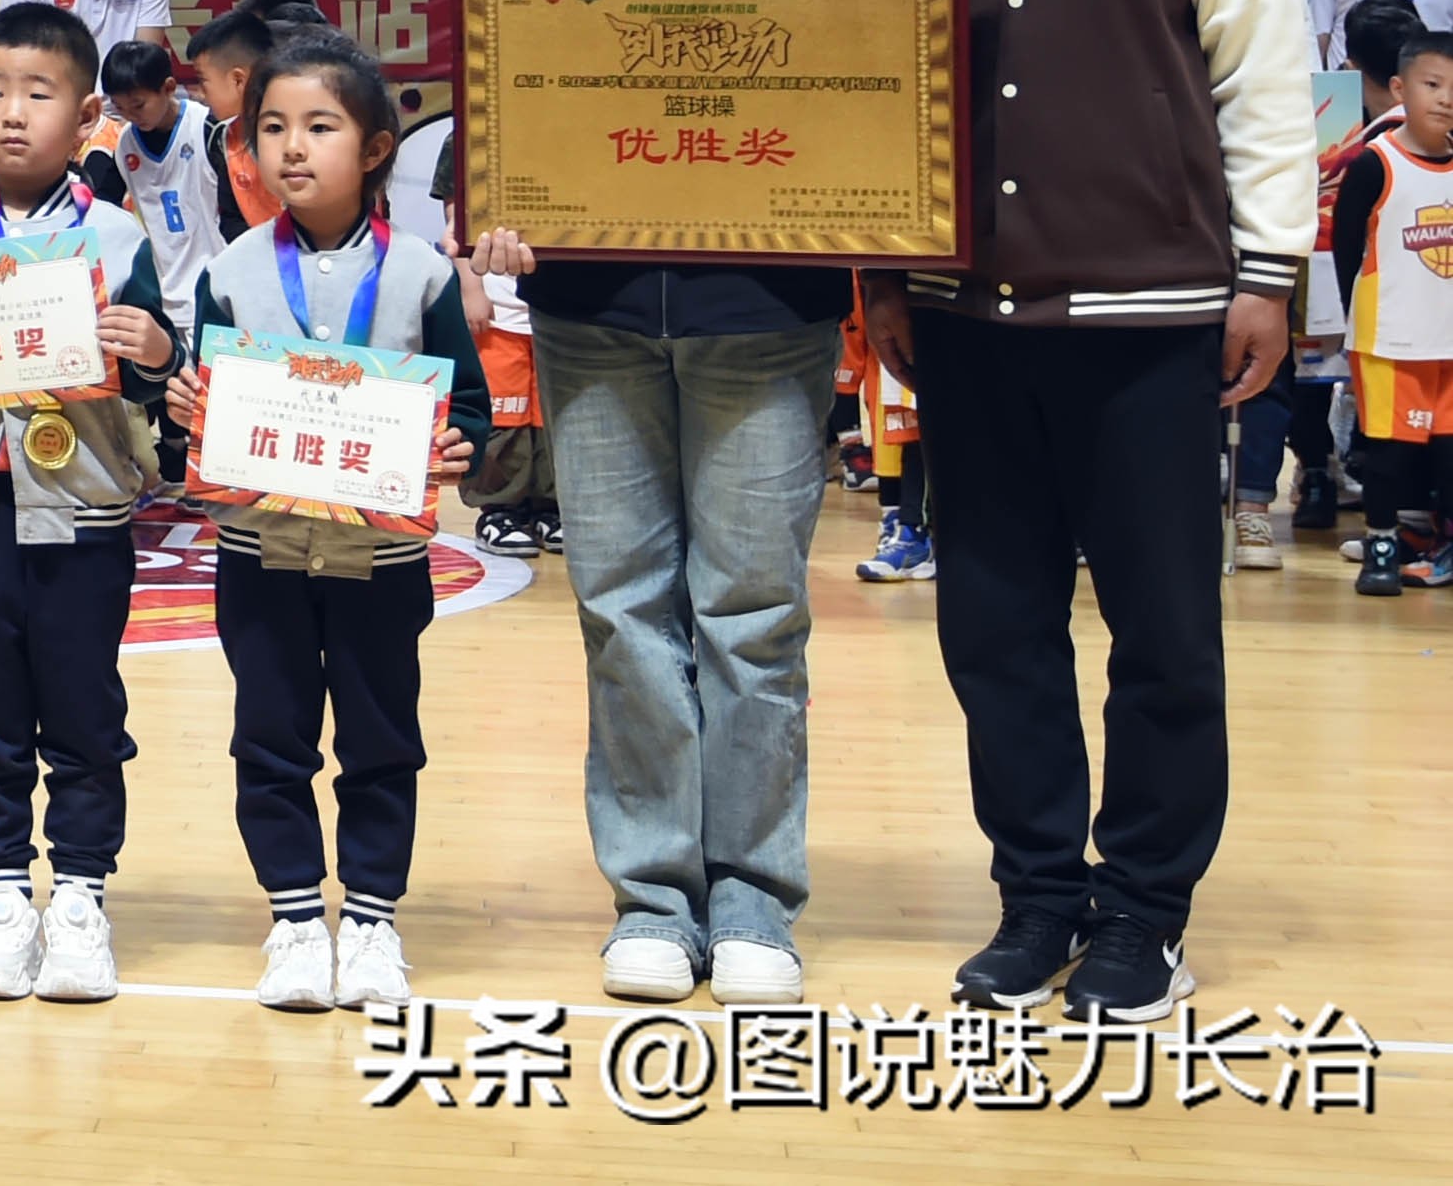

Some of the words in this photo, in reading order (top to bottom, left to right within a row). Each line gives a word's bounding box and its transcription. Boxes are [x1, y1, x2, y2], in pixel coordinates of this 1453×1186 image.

[664, 94, 736, 118] 篮球操
[607, 126, 796, 167] 优胜奖
[160, 190, 185, 233] 6
[248, 424, 373, 475] 优胜奖
